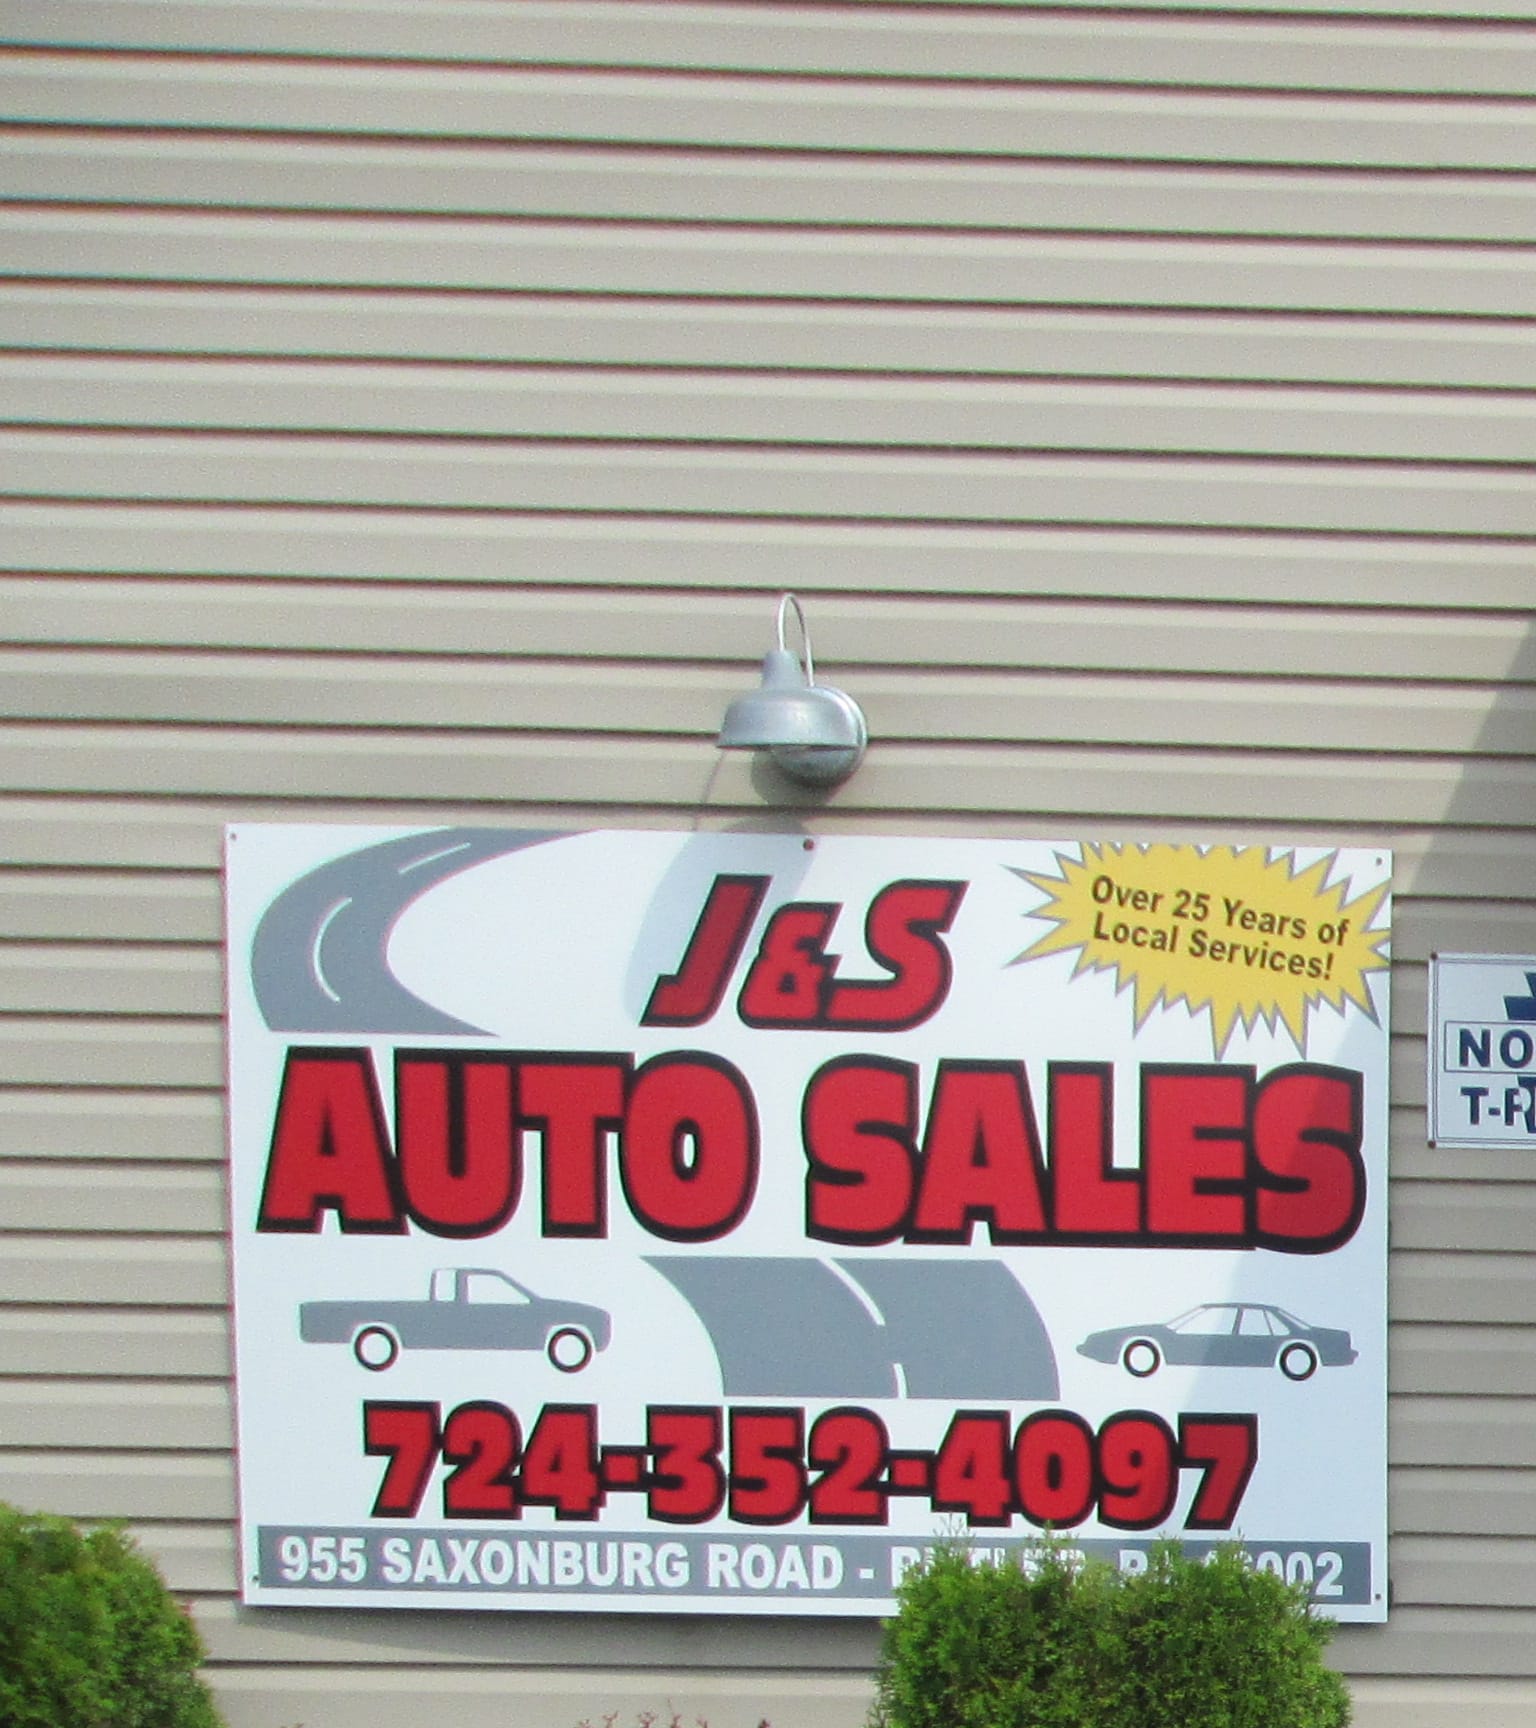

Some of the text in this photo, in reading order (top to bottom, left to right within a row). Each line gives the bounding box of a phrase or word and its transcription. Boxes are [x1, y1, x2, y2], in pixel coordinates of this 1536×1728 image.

[639, 874, 971, 1032] J&S
[1092, 875, 1350, 947] Over 25 Years of
[1093, 911, 1334, 981] Local Services!
[256, 1046, 1367, 1255] AUTO SALES
[363, 1400, 1258, 1530] 724-352-4097
[281, 1536, 368, 1582] 955
[382, 1538, 690, 1587] SAXONBURG
[707, 1543, 843, 1589] ROAD
[859, 1567, 874, 1580] -
